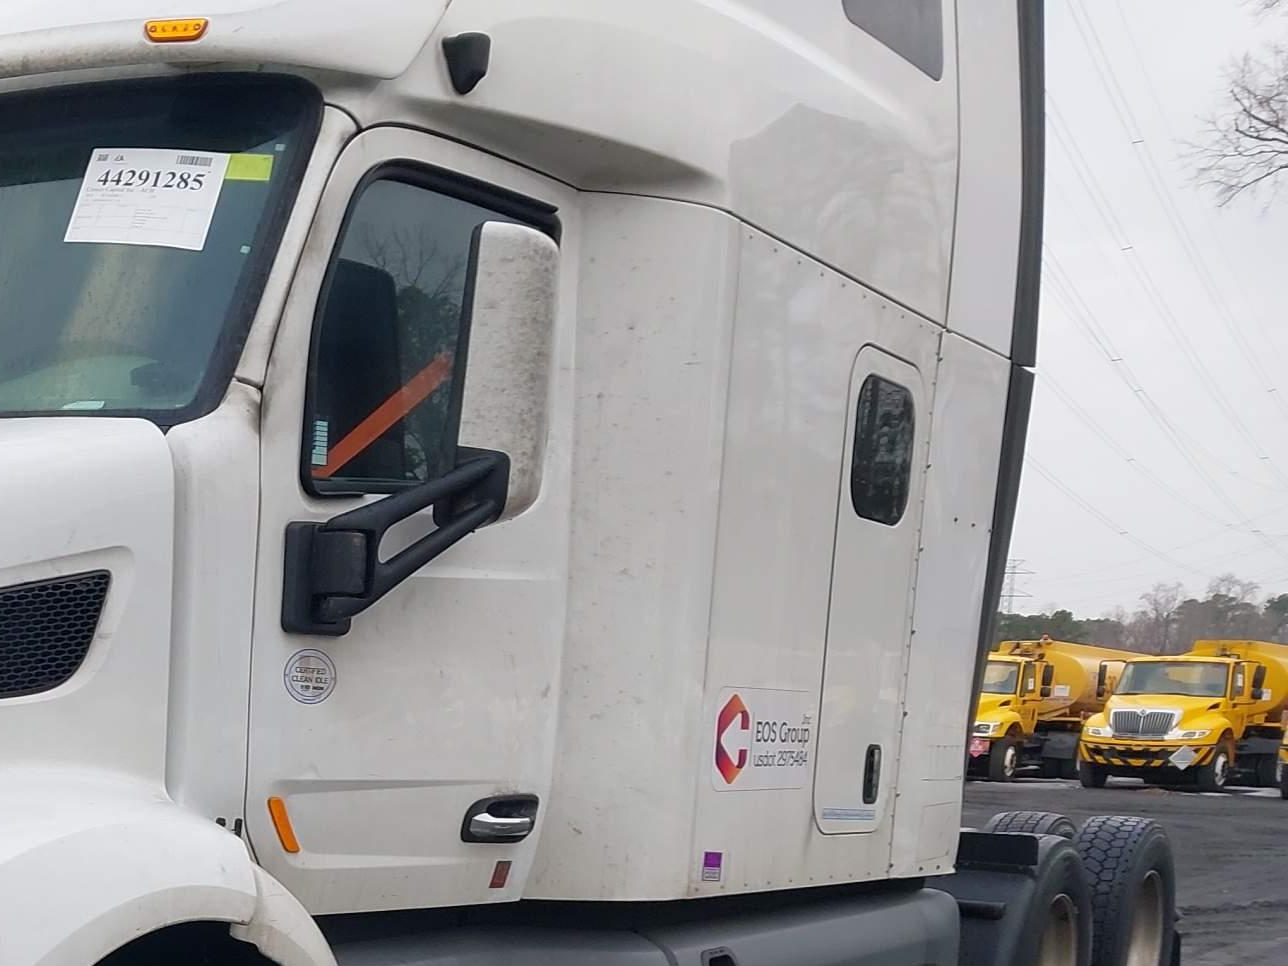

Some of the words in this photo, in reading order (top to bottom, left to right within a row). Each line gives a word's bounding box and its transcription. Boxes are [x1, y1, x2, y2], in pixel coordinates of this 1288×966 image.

[97, 168, 206, 191] 44291285
[755, 721, 777, 743] EOS
[779, 722, 810, 748] Group
